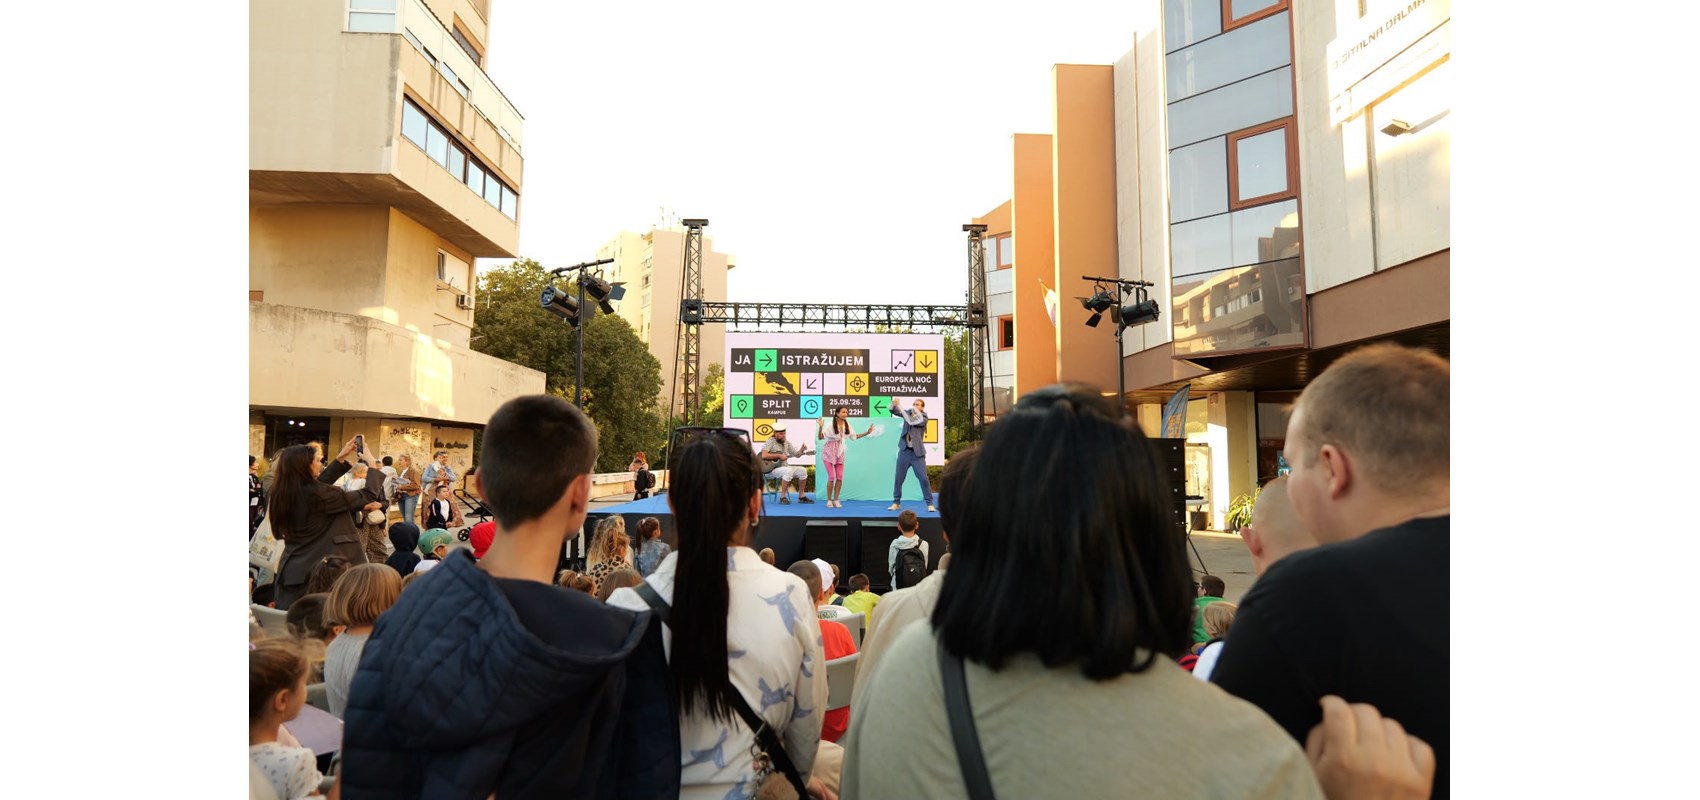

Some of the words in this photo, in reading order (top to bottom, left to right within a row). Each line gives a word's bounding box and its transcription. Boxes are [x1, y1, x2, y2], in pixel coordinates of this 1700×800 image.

[735, 354, 751, 365] JA
[782, 353, 864, 366] ISTRAŽUJEM
[915, 374, 932, 383] NOĆ
[880, 384, 927, 393] ISTRAŽIVAČA
[762, 400, 791, 409] SPLIT
